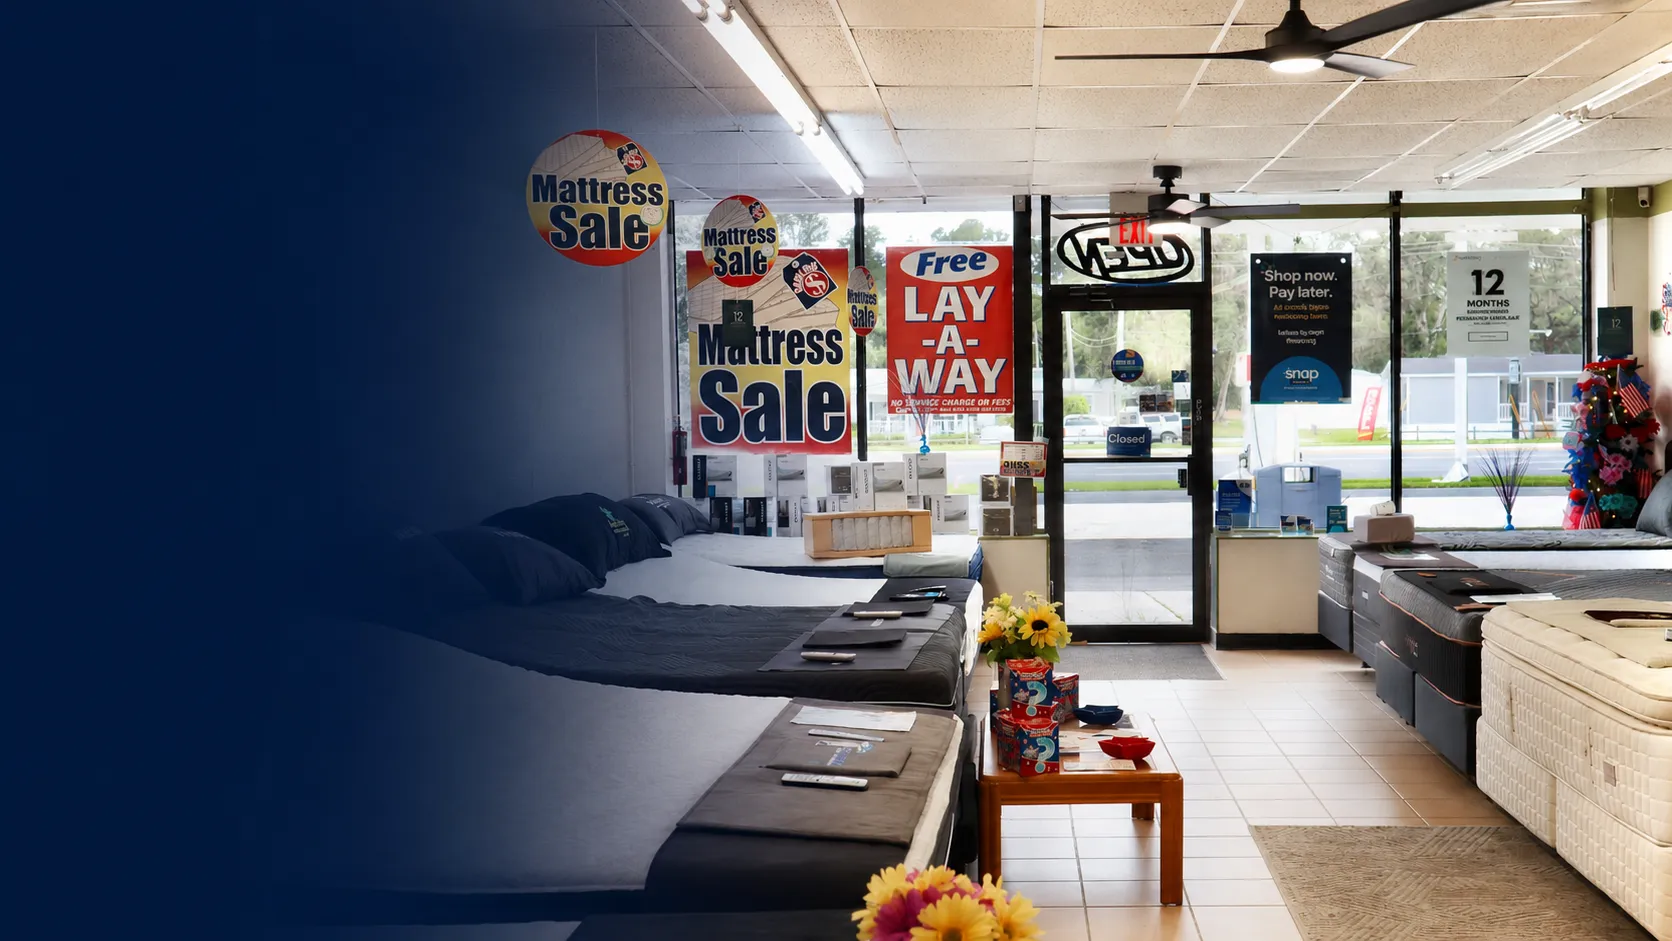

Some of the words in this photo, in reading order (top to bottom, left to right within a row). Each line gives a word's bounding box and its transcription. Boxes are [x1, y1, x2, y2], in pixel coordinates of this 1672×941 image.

[532, 174, 664, 206] Mattress
[549, 204, 650, 251] Sale
[704, 227, 777, 246] Mattress
[714, 246, 768, 278] Sale
[916, 251, 988, 276] Free
[1264, 269, 1301, 284] Shop
[1304, 271, 1338, 282] now.
[1471, 269, 1505, 296] 12
[904, 286, 997, 323] LAY
[1269, 286, 1295, 301] Pay
[1298, 286, 1333, 298] later.
[1467, 299, 1510, 308] MONTHS
[851, 304, 876, 328] Sale
[1611, 318, 1622, 329] 12
[698, 323, 844, 366] Mattress
[922, 325, 980, 355] -A-
[894, 358, 1008, 396] WAY
[1285, 369, 1319, 382] snap
[699, 368, 847, 445] Sale
[890, 399, 903, 407] NO
[942, 398, 975, 406] CHARGE
[1108, 433, 1145, 444] Closed
